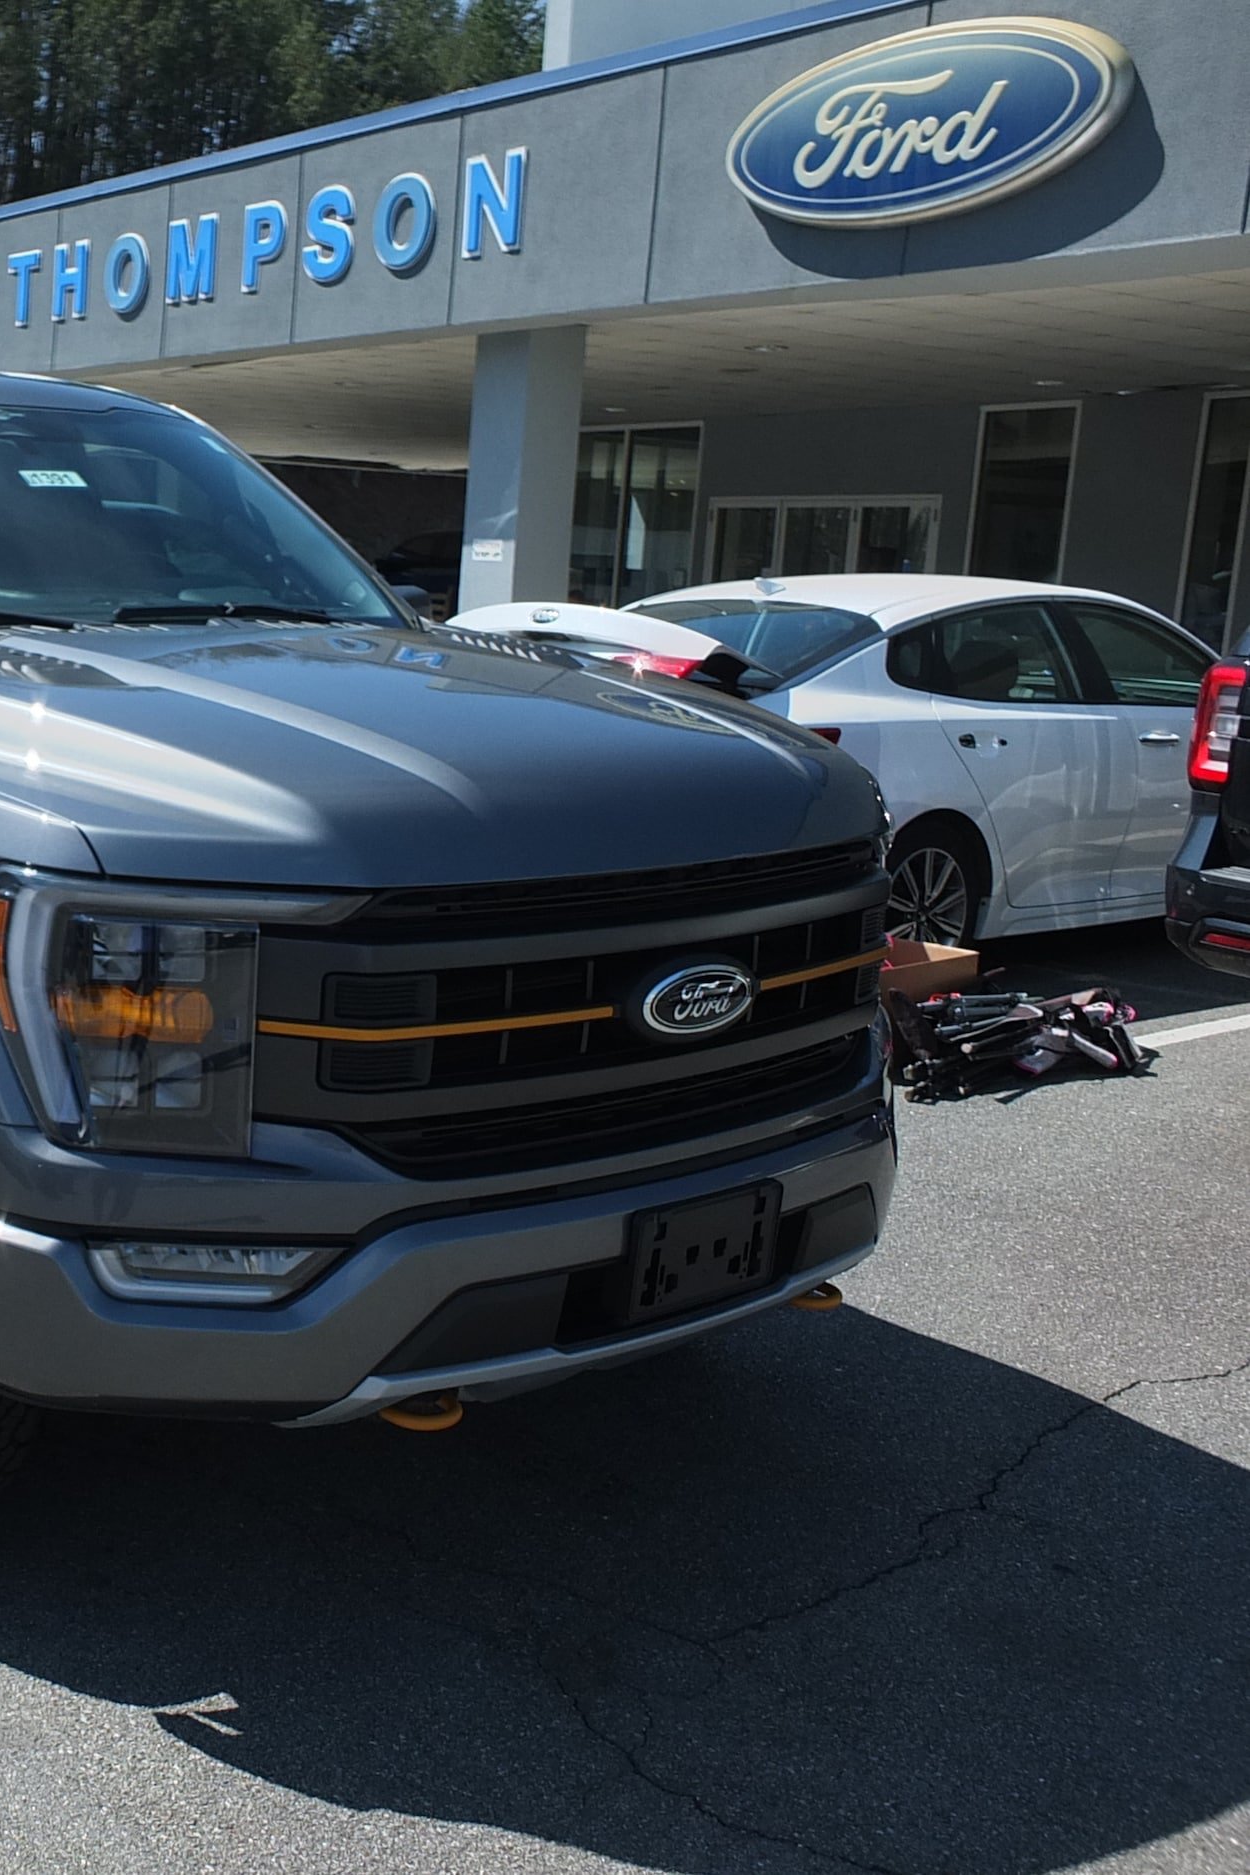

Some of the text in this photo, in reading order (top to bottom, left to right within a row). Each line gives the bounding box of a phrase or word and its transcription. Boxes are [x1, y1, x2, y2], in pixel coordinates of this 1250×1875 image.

[793, 70, 1009, 189] Ford
[8, 145, 529, 328] THOMPSON
[673, 980, 733, 1021] Ford
